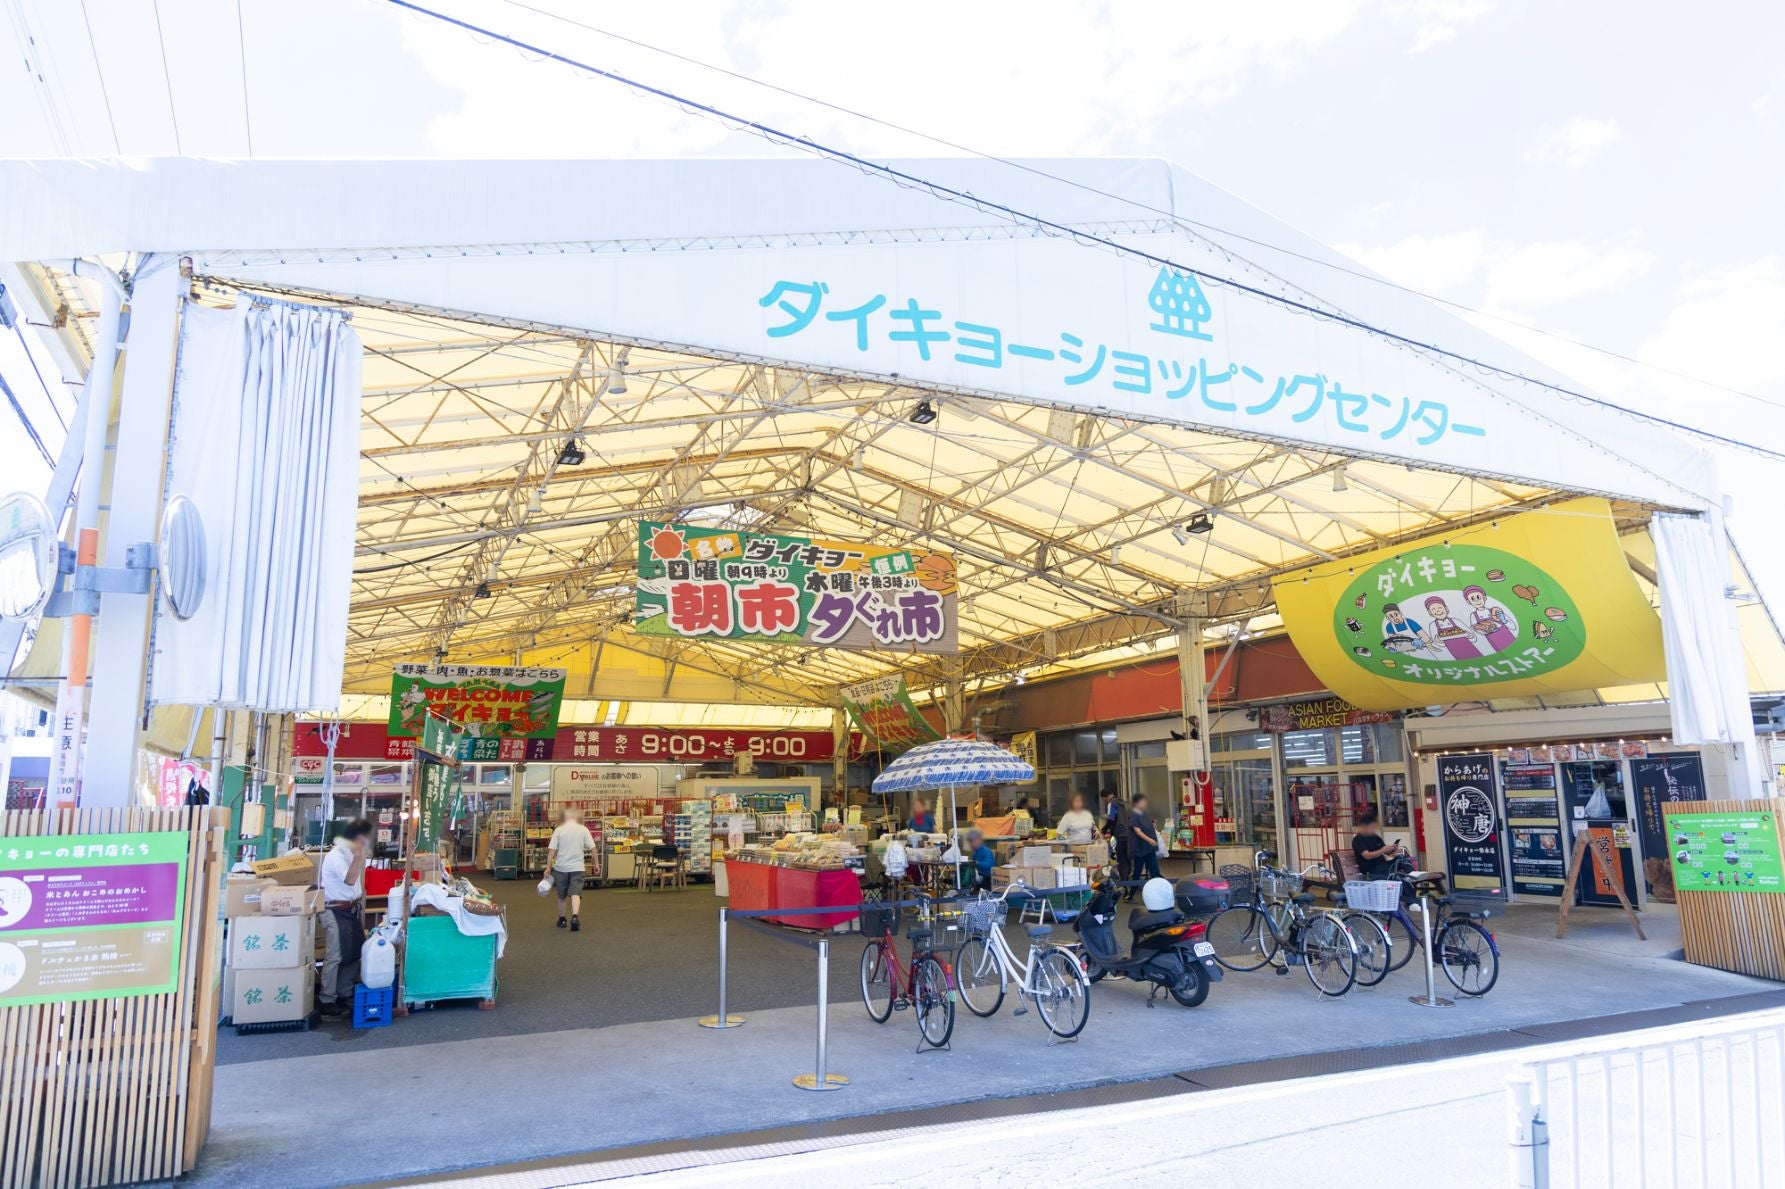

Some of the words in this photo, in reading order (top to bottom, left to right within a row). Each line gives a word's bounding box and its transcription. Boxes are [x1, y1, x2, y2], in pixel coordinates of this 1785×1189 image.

[759, 280, 1486, 446] ダイキョーショッピングセンター
[695, 538, 735, 556] 名物
[744, 539, 864, 567] ダイキョー
[667, 560, 718, 580] 日曜
[727, 565, 787, 580] 朝9時より
[874, 553, 909, 574] 恒例
[806, 572, 853, 593] 木曜
[859, 575, 918, 590] 午後3時より
[1377, 556, 1476, 598] ダイキョー
[671, 582, 797, 633] 朝市
[811, 591, 942, 640] 夕ぐれ市
[1402, 646, 1555, 680] オリジナルストアー
[423, 687, 535, 704] WELCOME
[1287, 702, 1323, 717] ASIAN
[1300, 713, 1348, 728] MARKET
[574, 730, 600, 743] 営業
[615, 733, 628, 754] あさ
[573, 745, 600, 757] 時間
[1444, 764, 1488, 775] からあげの
[0, 843, 149, 860] キョーの専門店たち
[243, 933, 291, 951] 銘茶
[244, 985, 293, 1005] 銘茶
